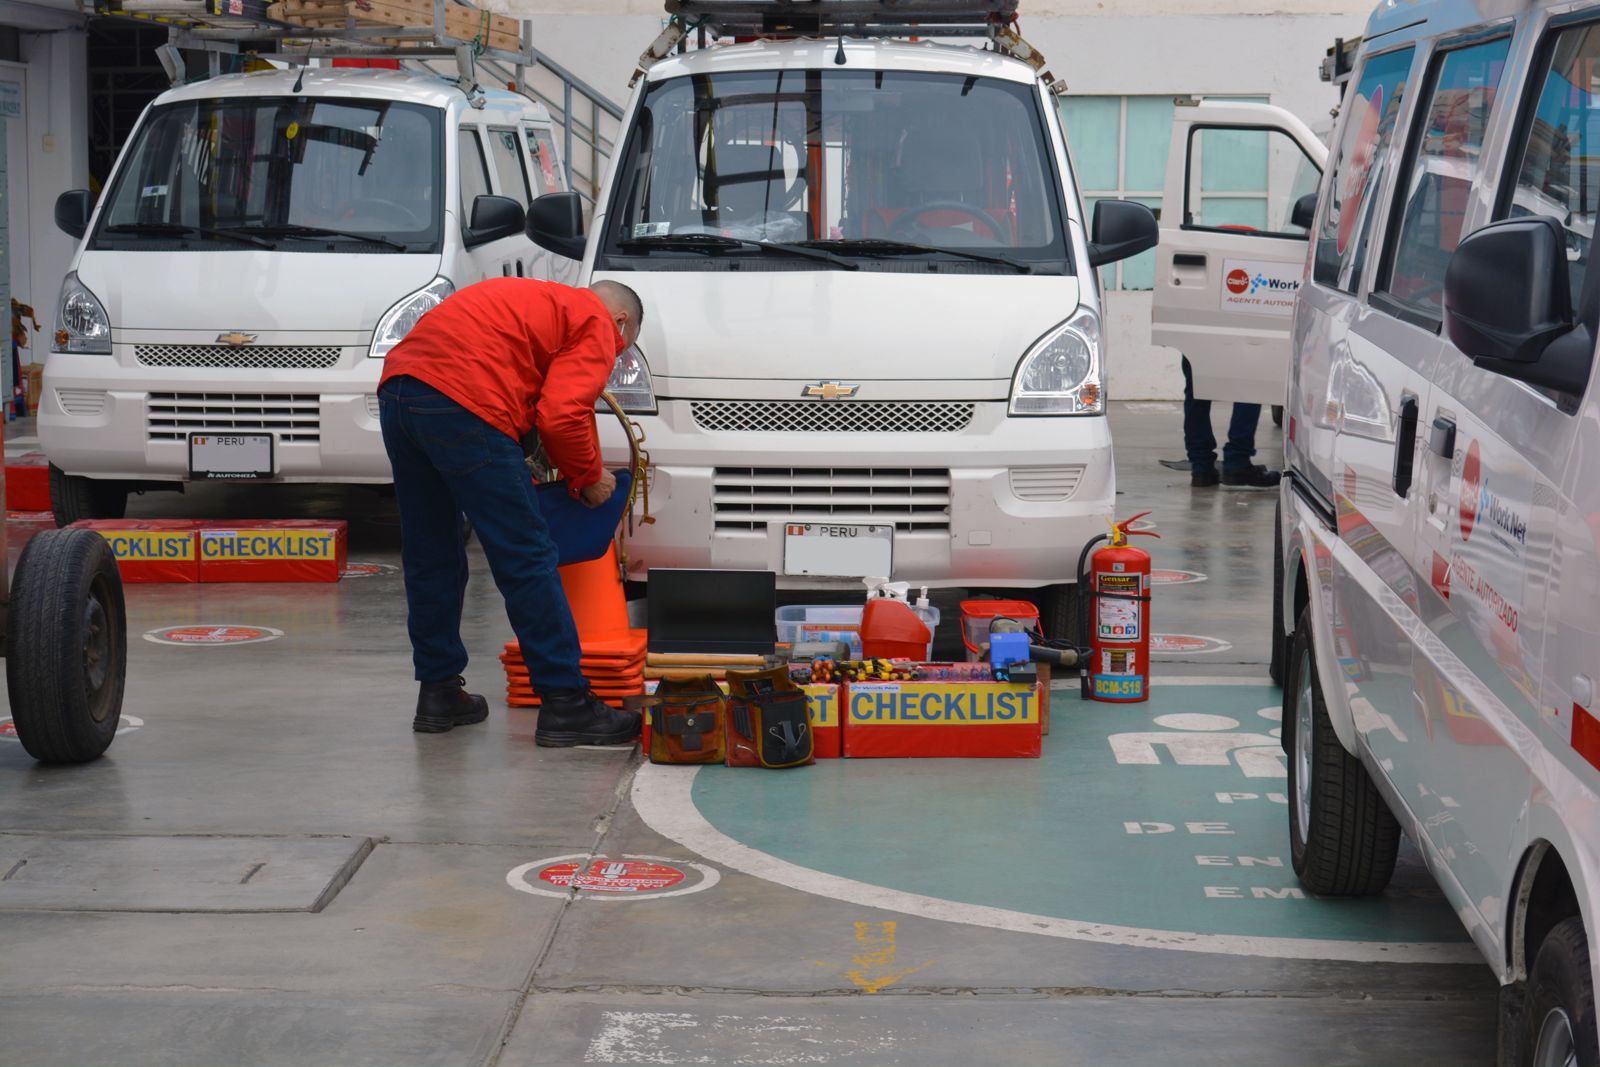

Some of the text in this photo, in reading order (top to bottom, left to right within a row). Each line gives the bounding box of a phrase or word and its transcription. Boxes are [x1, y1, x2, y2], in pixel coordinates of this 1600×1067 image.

[1268, 279, 1300, 290] Work
[1227, 297, 1294, 307] AGENTE AUTOR
[217, 437, 246, 446] PERU
[1489, 493, 1511, 532] Work
[1509, 511, 1527, 545] Net
[819, 526, 858, 538] PERU
[105, 536, 331, 557] CKLIST CHECKLIST
[1100, 574, 1131, 583] Gensar
[1476, 576, 1519, 633] AUTORIZADO
[1096, 680, 1142, 695] BCM-518
[851, 692, 1035, 720] CHECKLIST
[1123, 821, 1236, 834] DE
[1194, 855, 1284, 867] EN
[1203, 886, 1308, 899] EM
